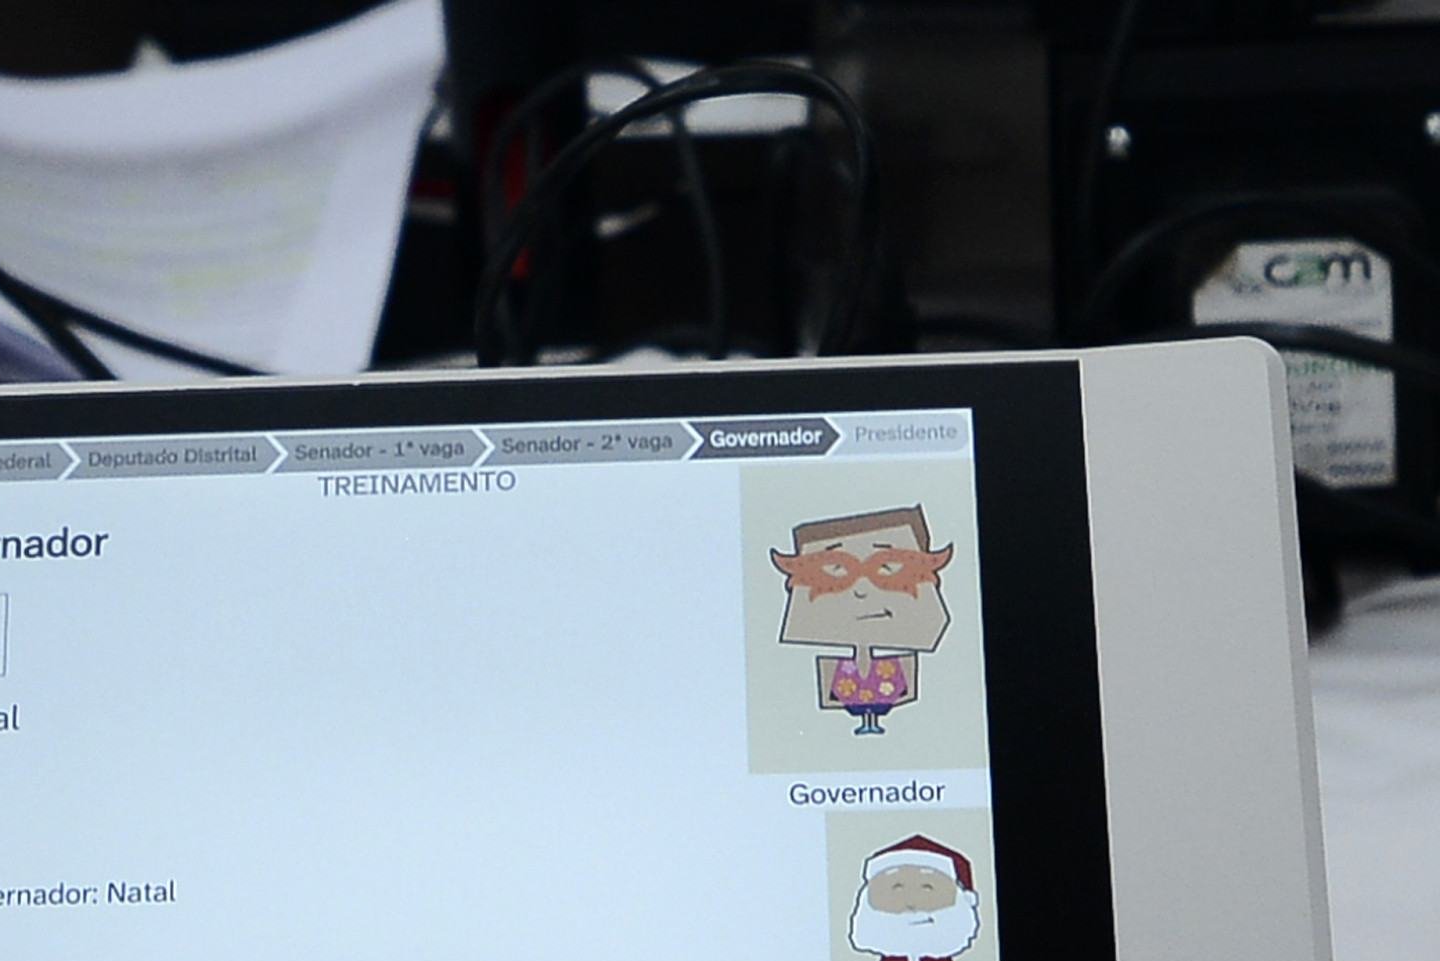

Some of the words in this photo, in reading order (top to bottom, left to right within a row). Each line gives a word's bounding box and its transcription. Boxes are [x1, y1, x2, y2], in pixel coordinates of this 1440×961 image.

[710, 427, 823, 448] Governador
[855, 424, 958, 443] Presidente
[295, 444, 373, 460] Senador
[421, 444, 465, 459] vaga
[502, 436, 581, 454] Senador
[628, 438, 673, 453] vaga
[89, 450, 178, 468] Deputado
[185, 447, 257, 464] Distrital
[318, 470, 517, 497] TREINAMENTO
[789, 781, 946, 805] Governador
[107, 881, 176, 904] Natal
